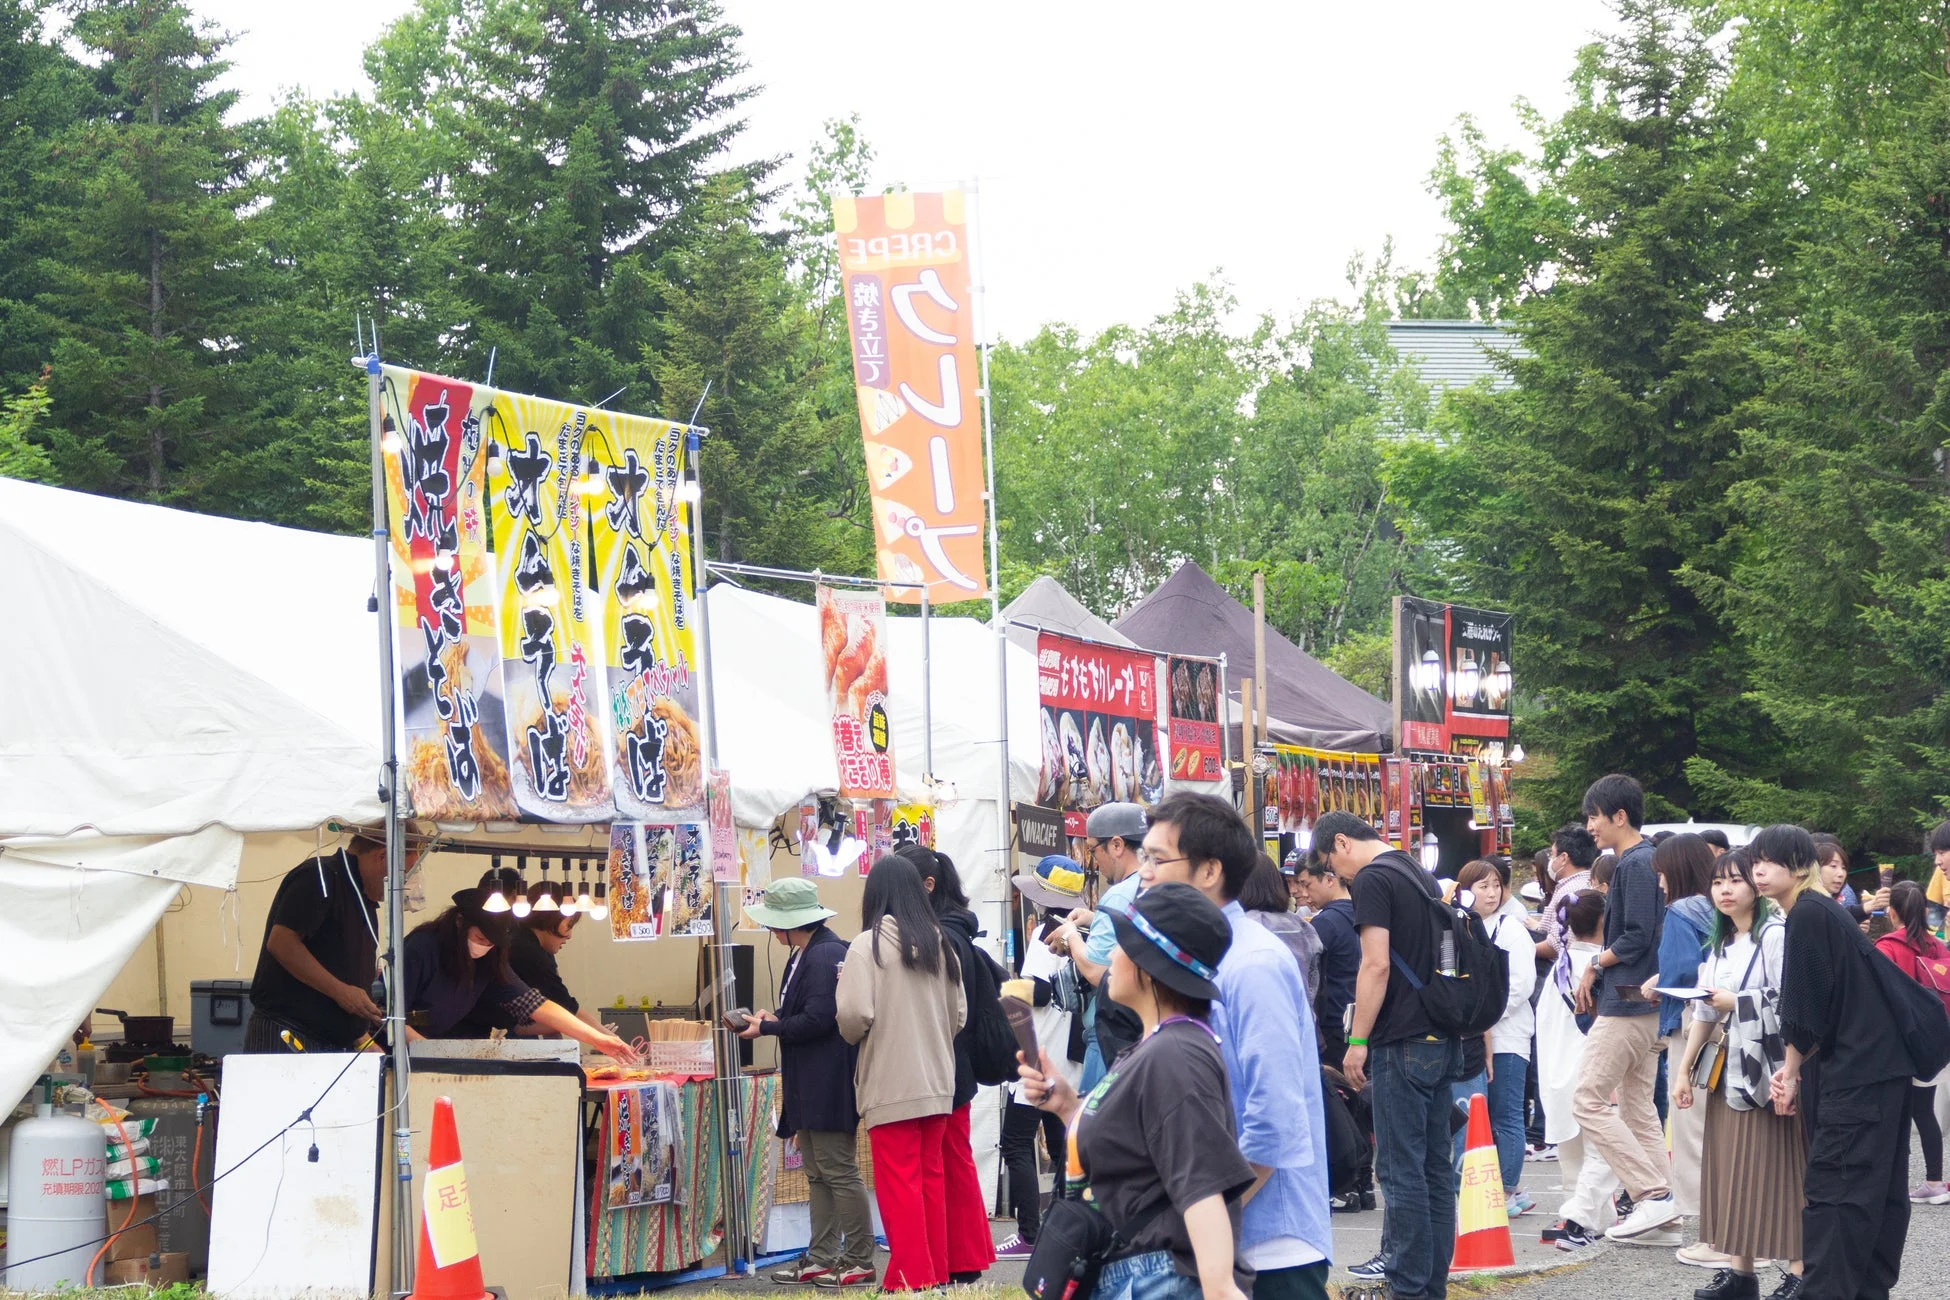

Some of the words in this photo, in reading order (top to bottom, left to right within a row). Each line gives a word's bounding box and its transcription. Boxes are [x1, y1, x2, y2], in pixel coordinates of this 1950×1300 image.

[505, 431, 568, 801] オムそば
[605, 448, 668, 804] オムそば
[42, 1157, 105, 1176] 燃LPガス
[1463, 1163, 1502, 1188] 足元
